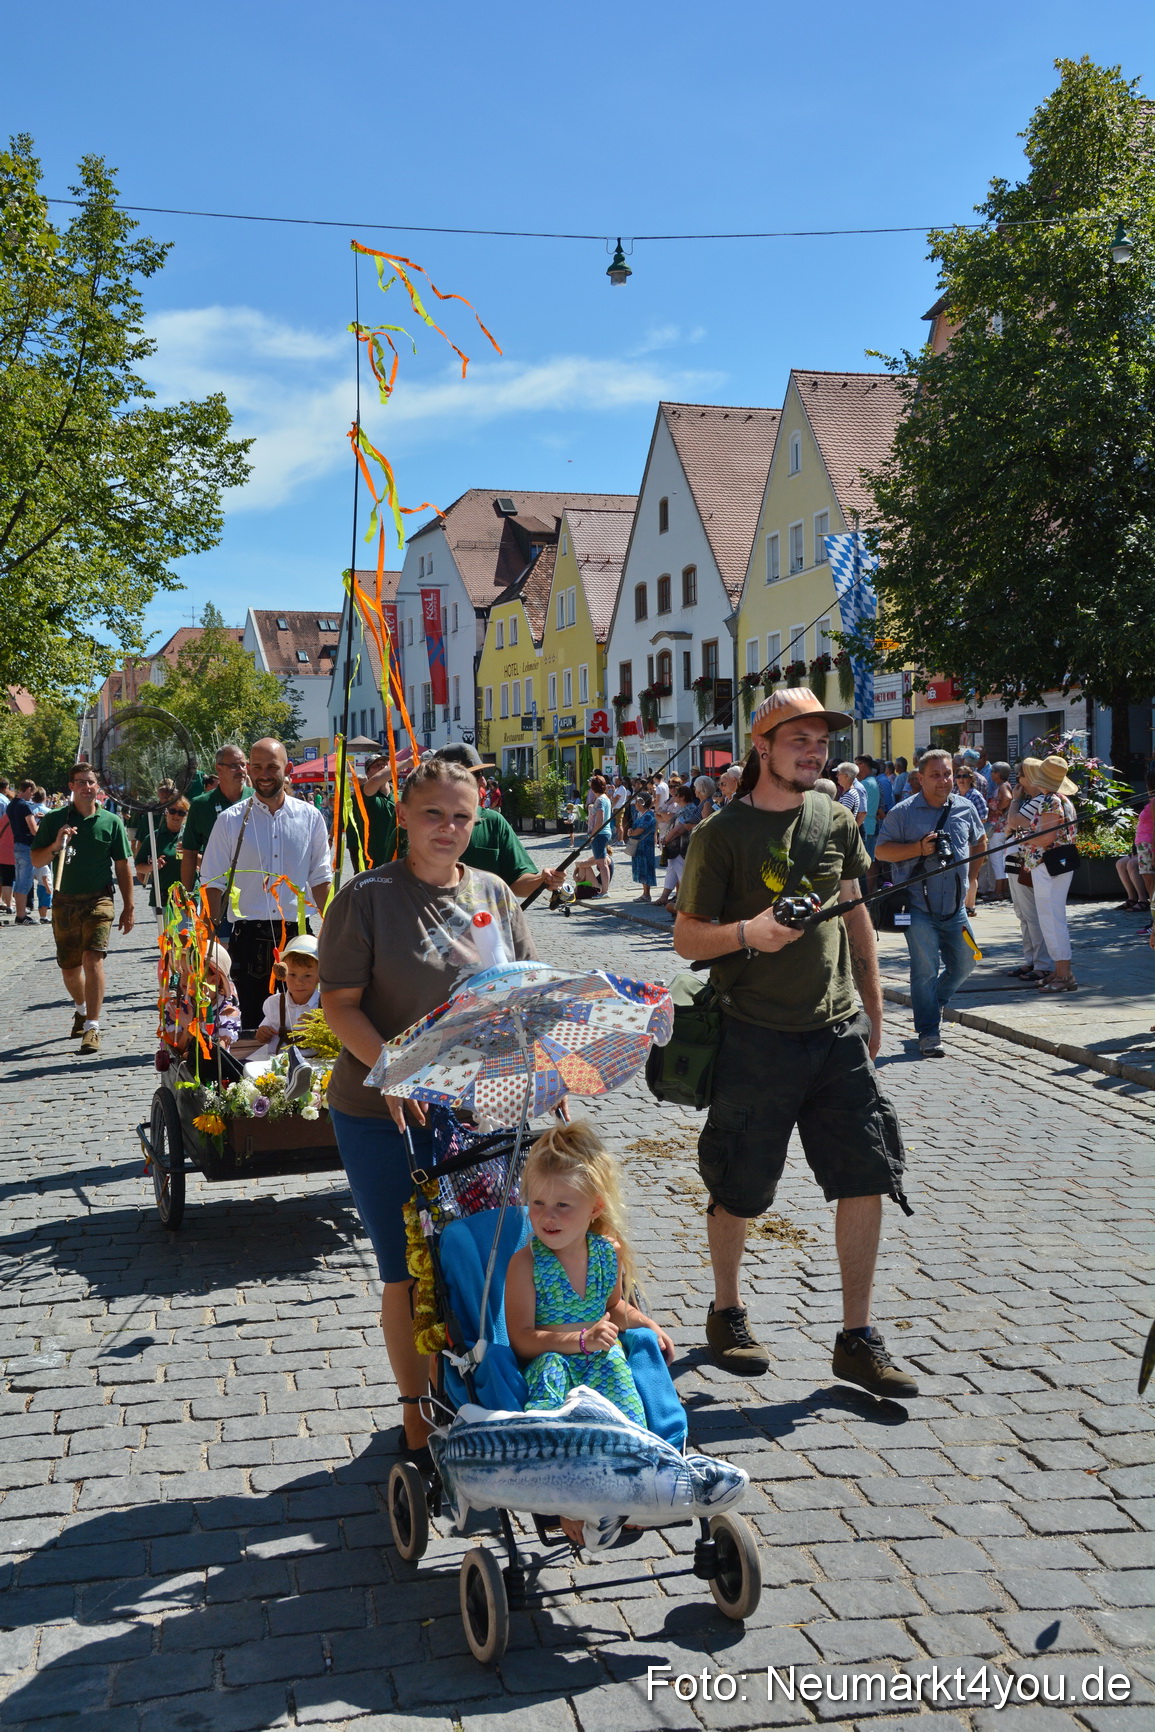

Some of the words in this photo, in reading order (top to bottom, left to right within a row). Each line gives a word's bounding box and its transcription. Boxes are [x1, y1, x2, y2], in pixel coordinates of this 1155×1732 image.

[424, 593, 434, 620] K&L
[503, 662, 519, 678] HOTEL
[560, 717, 573, 728] AIFUN
[504, 732, 525, 743] Restaurant
[359, 877, 393, 888] PROLOGIC
